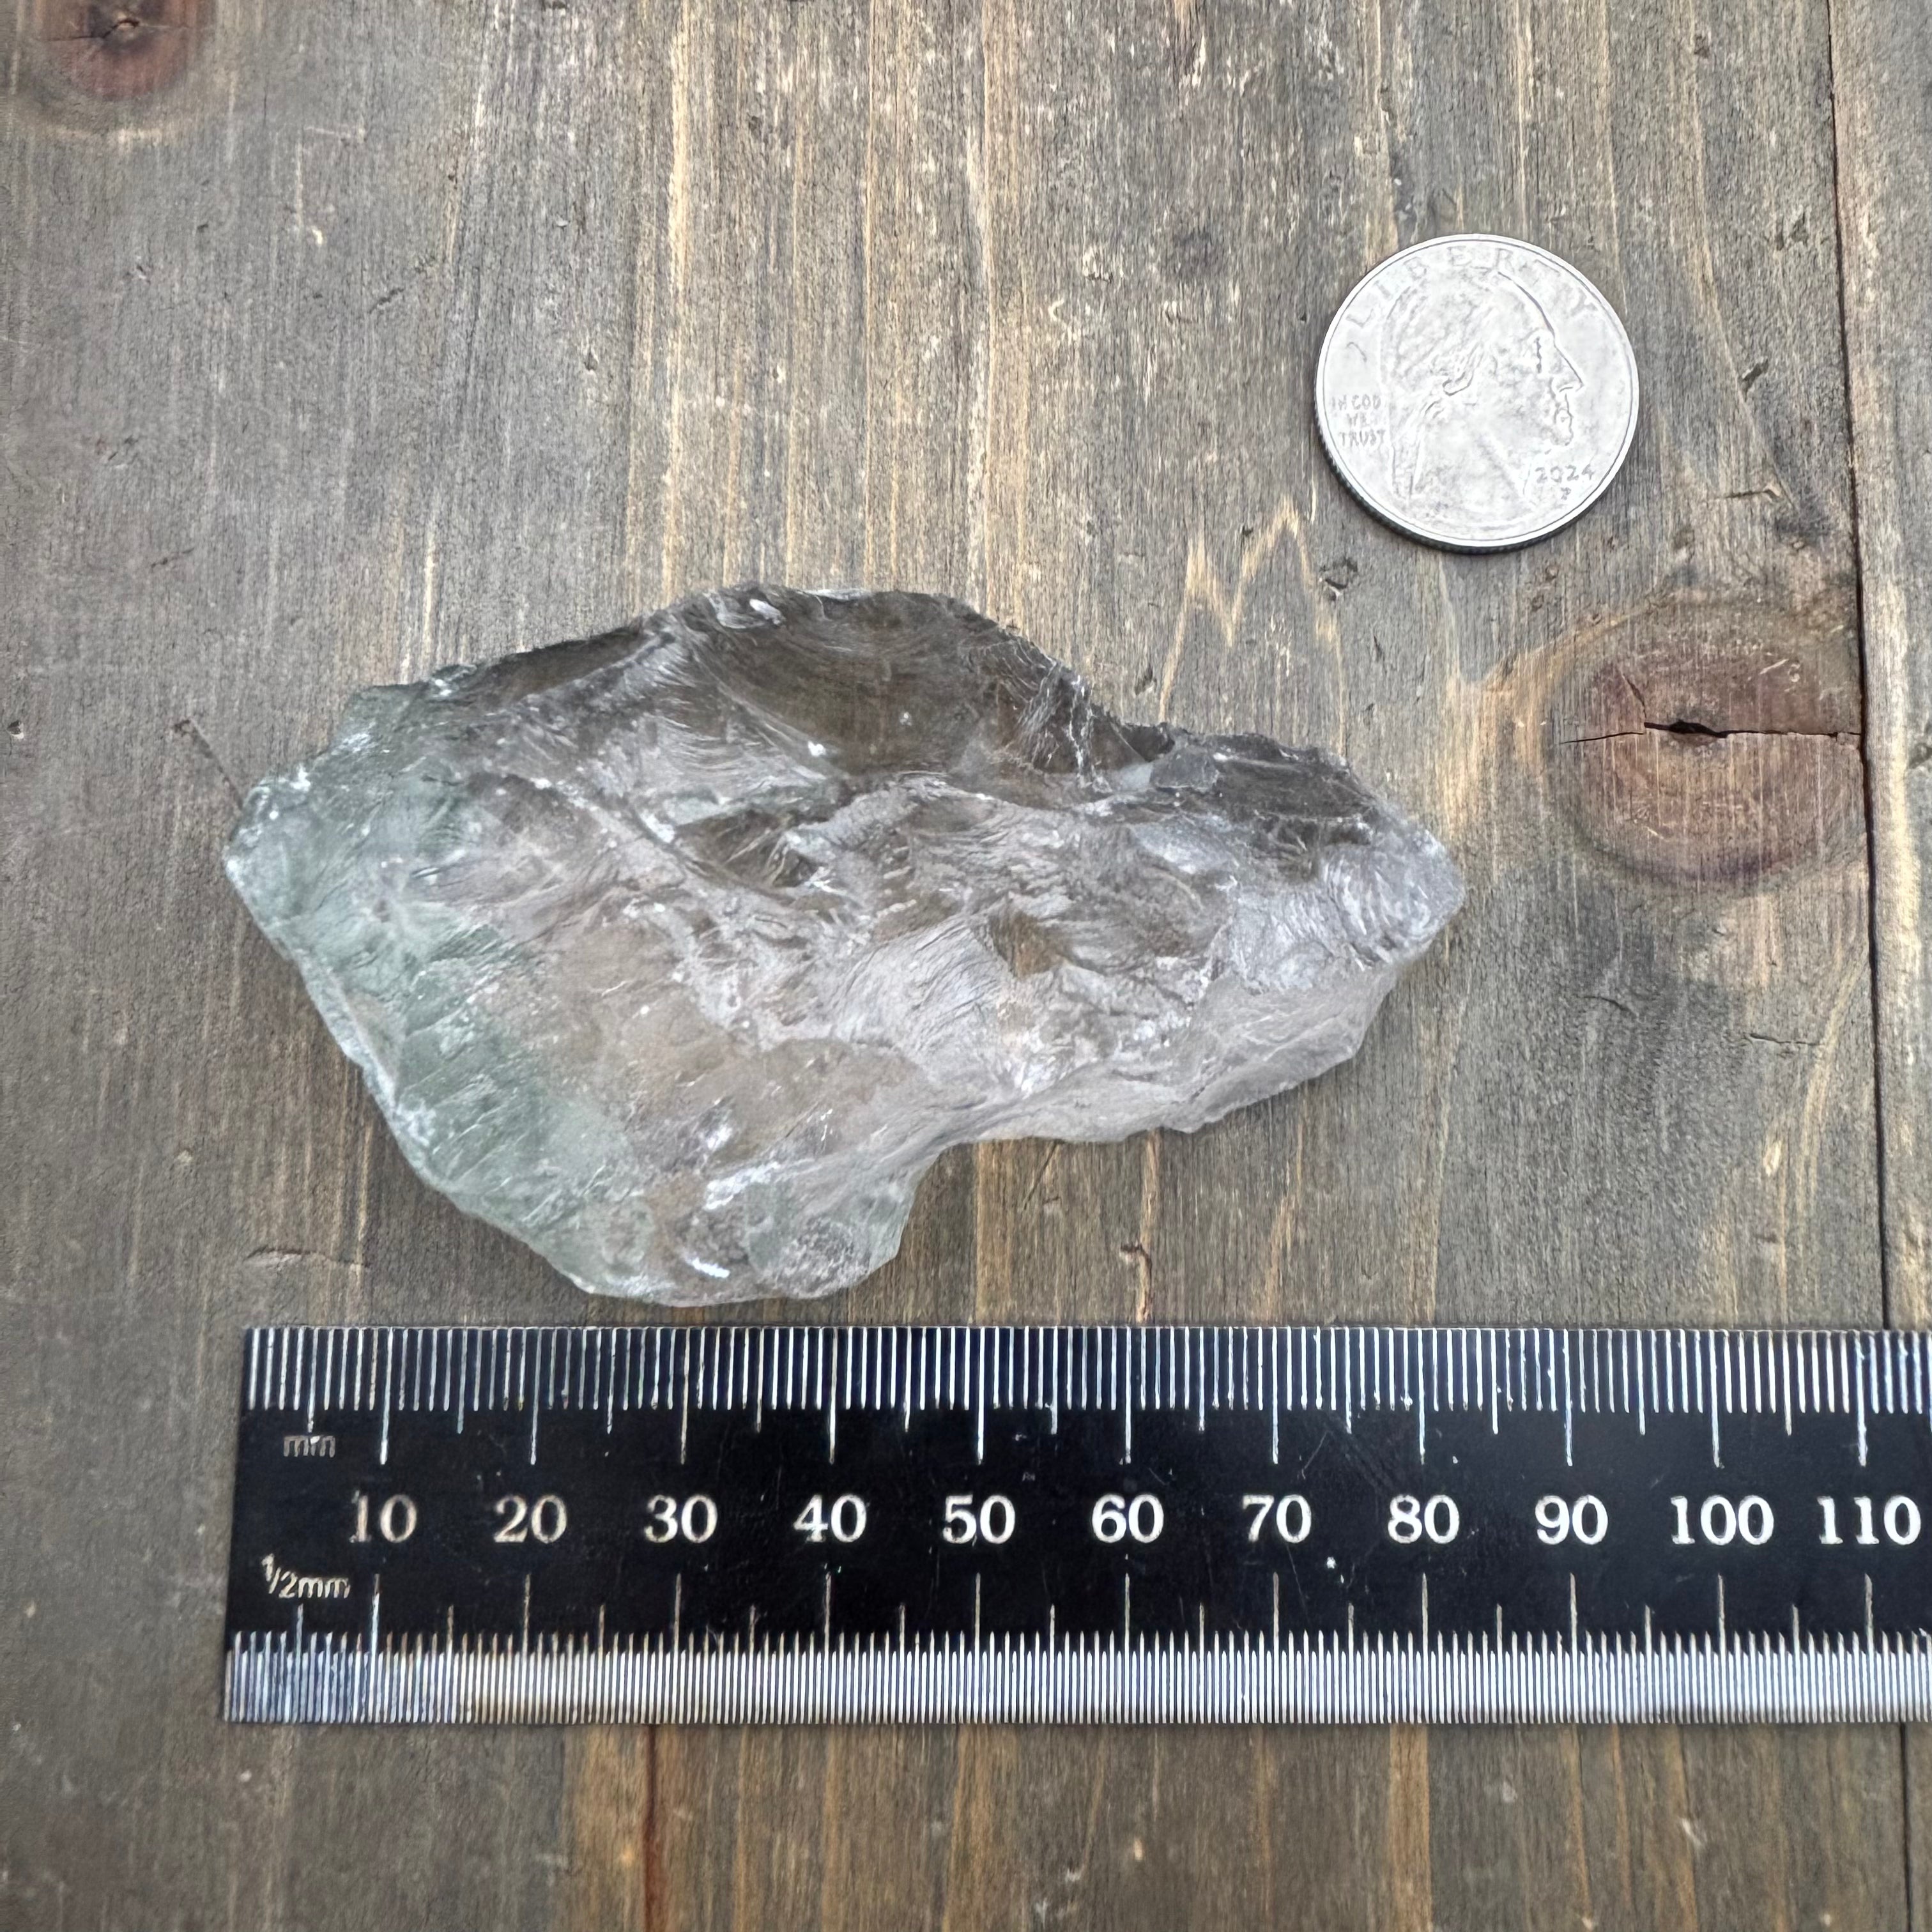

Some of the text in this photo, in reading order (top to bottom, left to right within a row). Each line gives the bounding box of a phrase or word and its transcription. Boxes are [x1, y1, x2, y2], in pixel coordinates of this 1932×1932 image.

[1346, 246, 1598, 328] LIBERTY
[1332, 394, 1347, 411] IN
[1338, 429, 1386, 447] TRUST
[1535, 463, 1596, 484] 2024
[284, 1436, 336, 1457] mm
[349, 1493, 1922, 1546] 10 20 30 40 50 60 70 80 90 100 110
